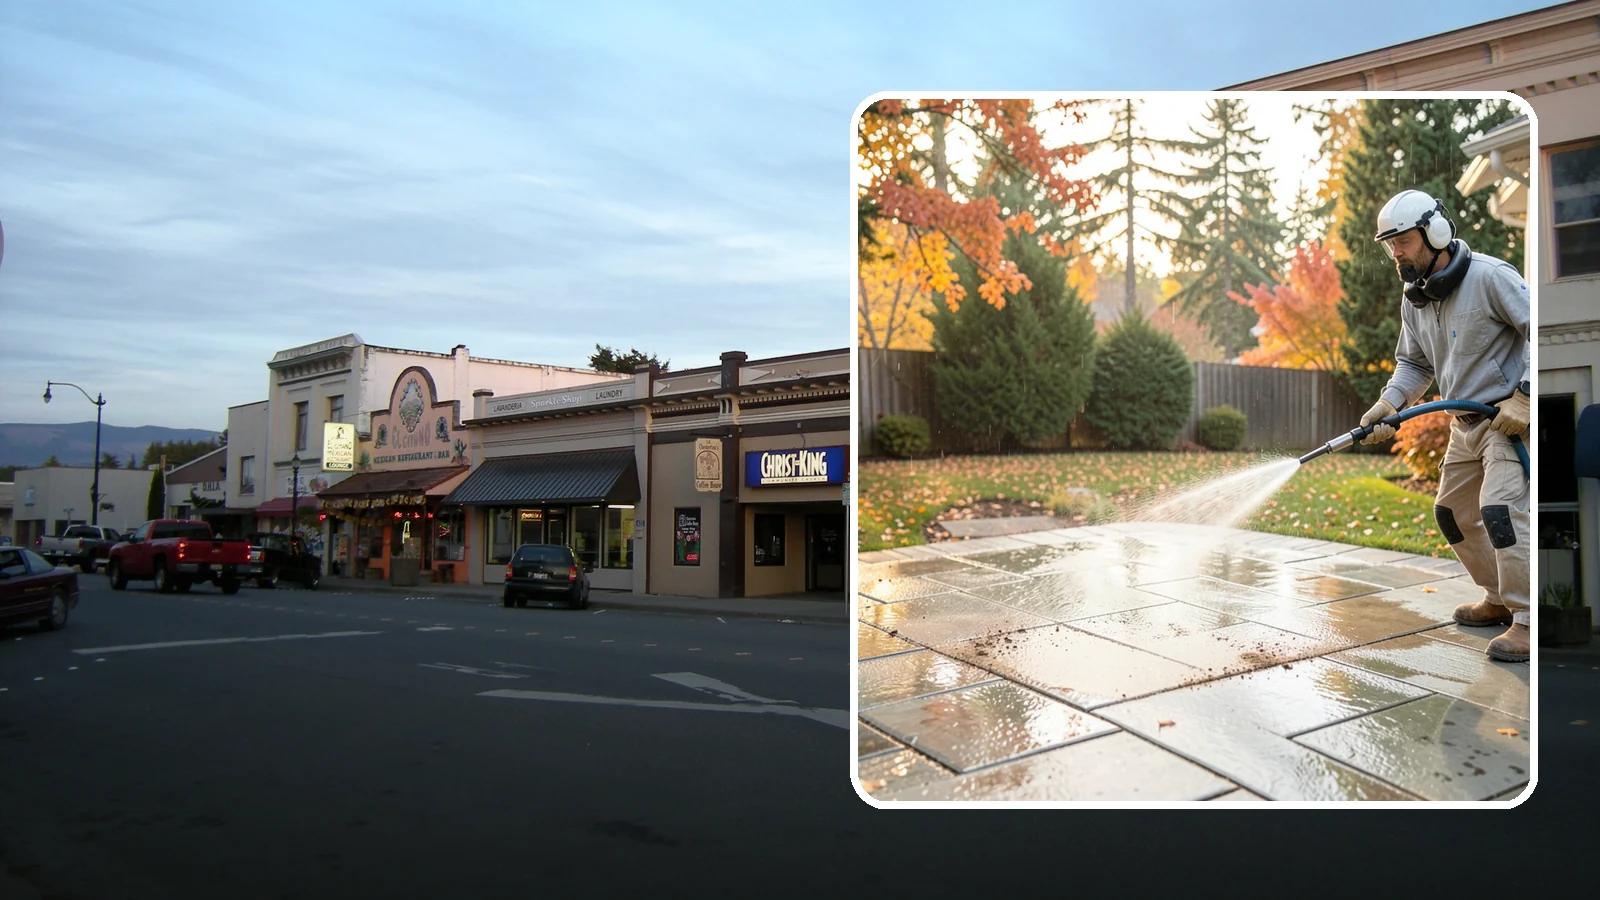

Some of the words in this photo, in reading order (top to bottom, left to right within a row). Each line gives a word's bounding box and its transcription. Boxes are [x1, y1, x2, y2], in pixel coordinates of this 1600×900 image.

[531, 396, 560, 409] Sparkle
[562, 394, 582, 405] Shop
[595, 389, 623, 400] LAUNDRY
[493, 402, 522, 413] LAVANDERIA
[392, 425, 401, 449] EL
[373, 454, 396, 465] MEXICAN
[398, 451, 433, 463] RESTAURANT
[438, 449, 450, 460] BAR
[761, 452, 797, 478] CHRIST
[799, 450, 827, 476] KING
[697, 480, 709, 489] Coffee
[710, 480, 721, 489] House
